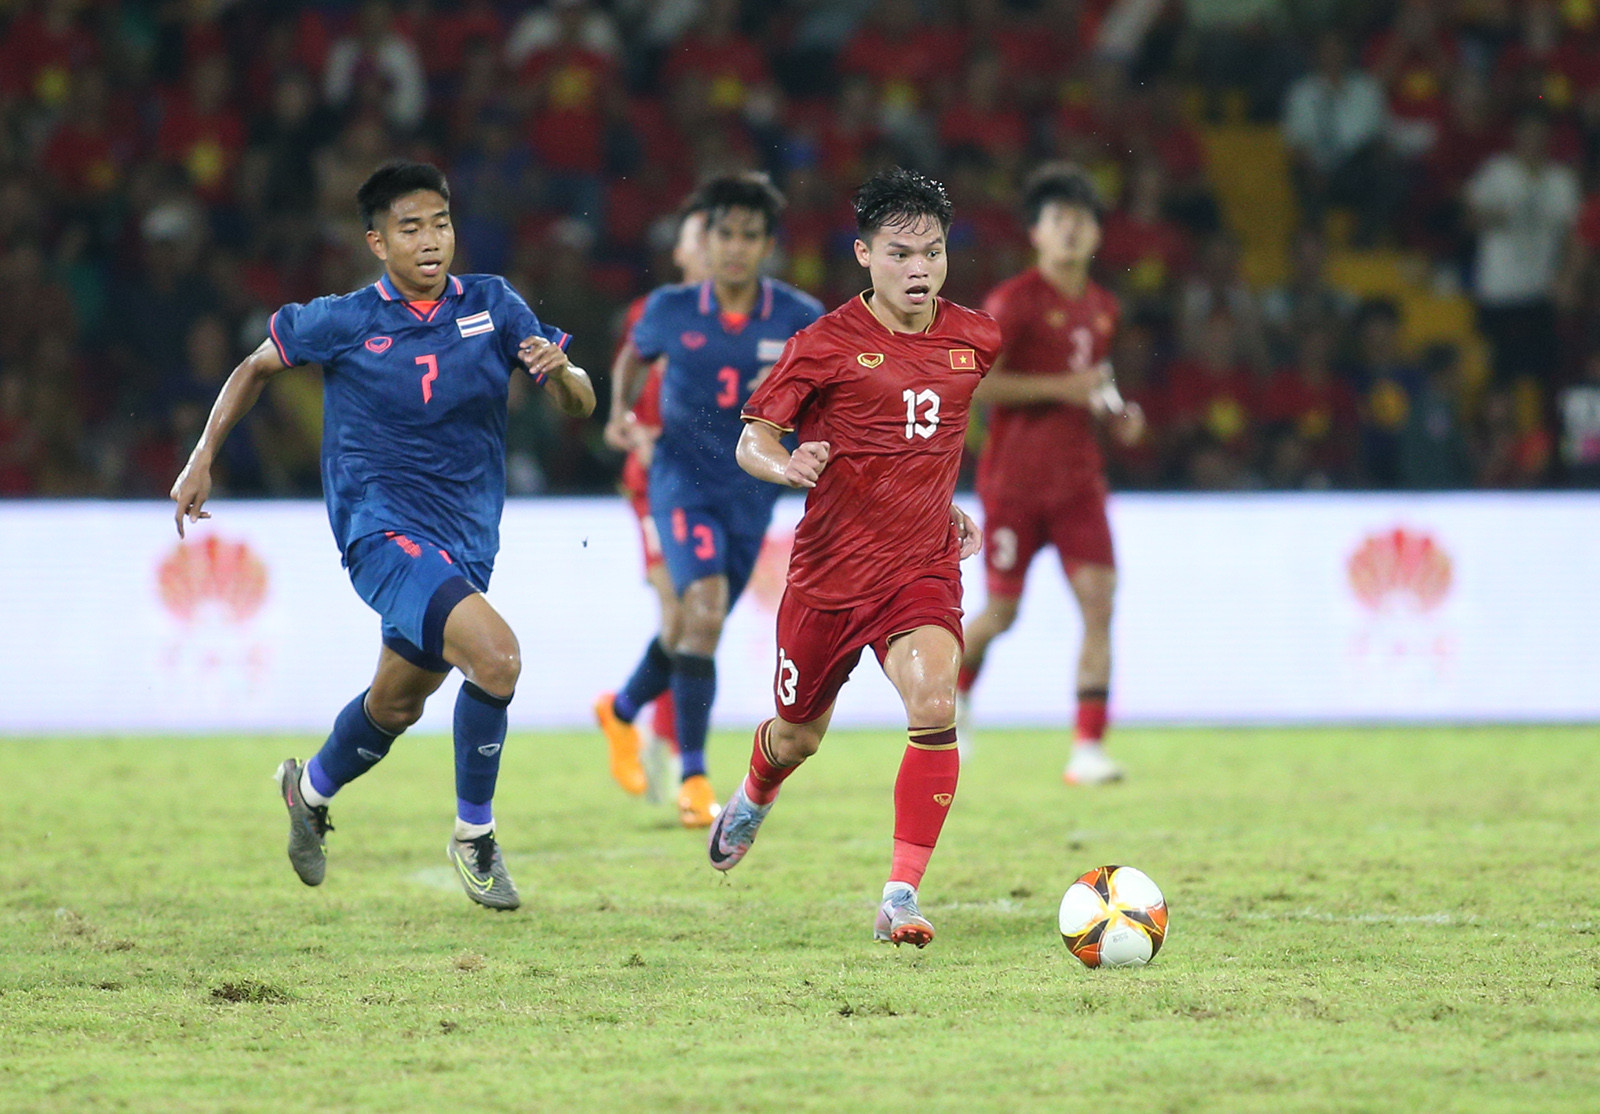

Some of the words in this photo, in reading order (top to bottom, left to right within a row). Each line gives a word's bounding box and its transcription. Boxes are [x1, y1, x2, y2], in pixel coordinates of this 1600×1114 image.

[414, 354, 439, 404] 7
[717, 366, 739, 408] 3
[903, 388, 941, 439] 13
[692, 523, 716, 560] 3
[991, 526, 1019, 570] 3
[777, 647, 800, 706] 13
